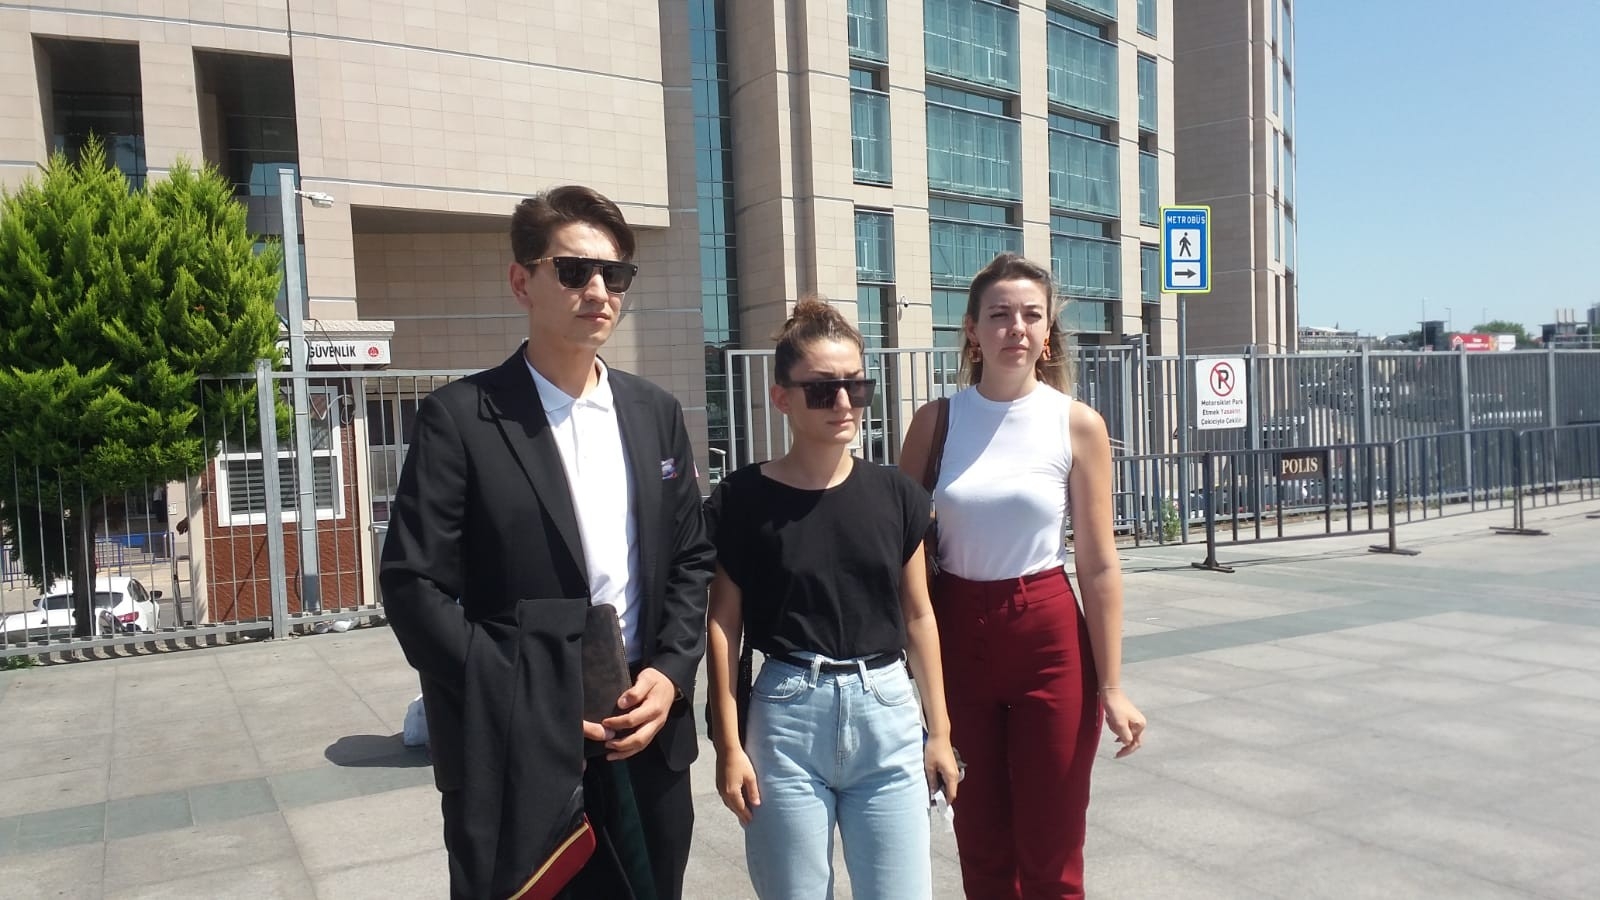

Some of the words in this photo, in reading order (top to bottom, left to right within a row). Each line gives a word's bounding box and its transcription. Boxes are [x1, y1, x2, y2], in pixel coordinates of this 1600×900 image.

[1167, 215, 1206, 224] METROBÜS
[309, 344, 356, 358] GÜVENLİK
[1202, 408, 1219, 416] Etmek
